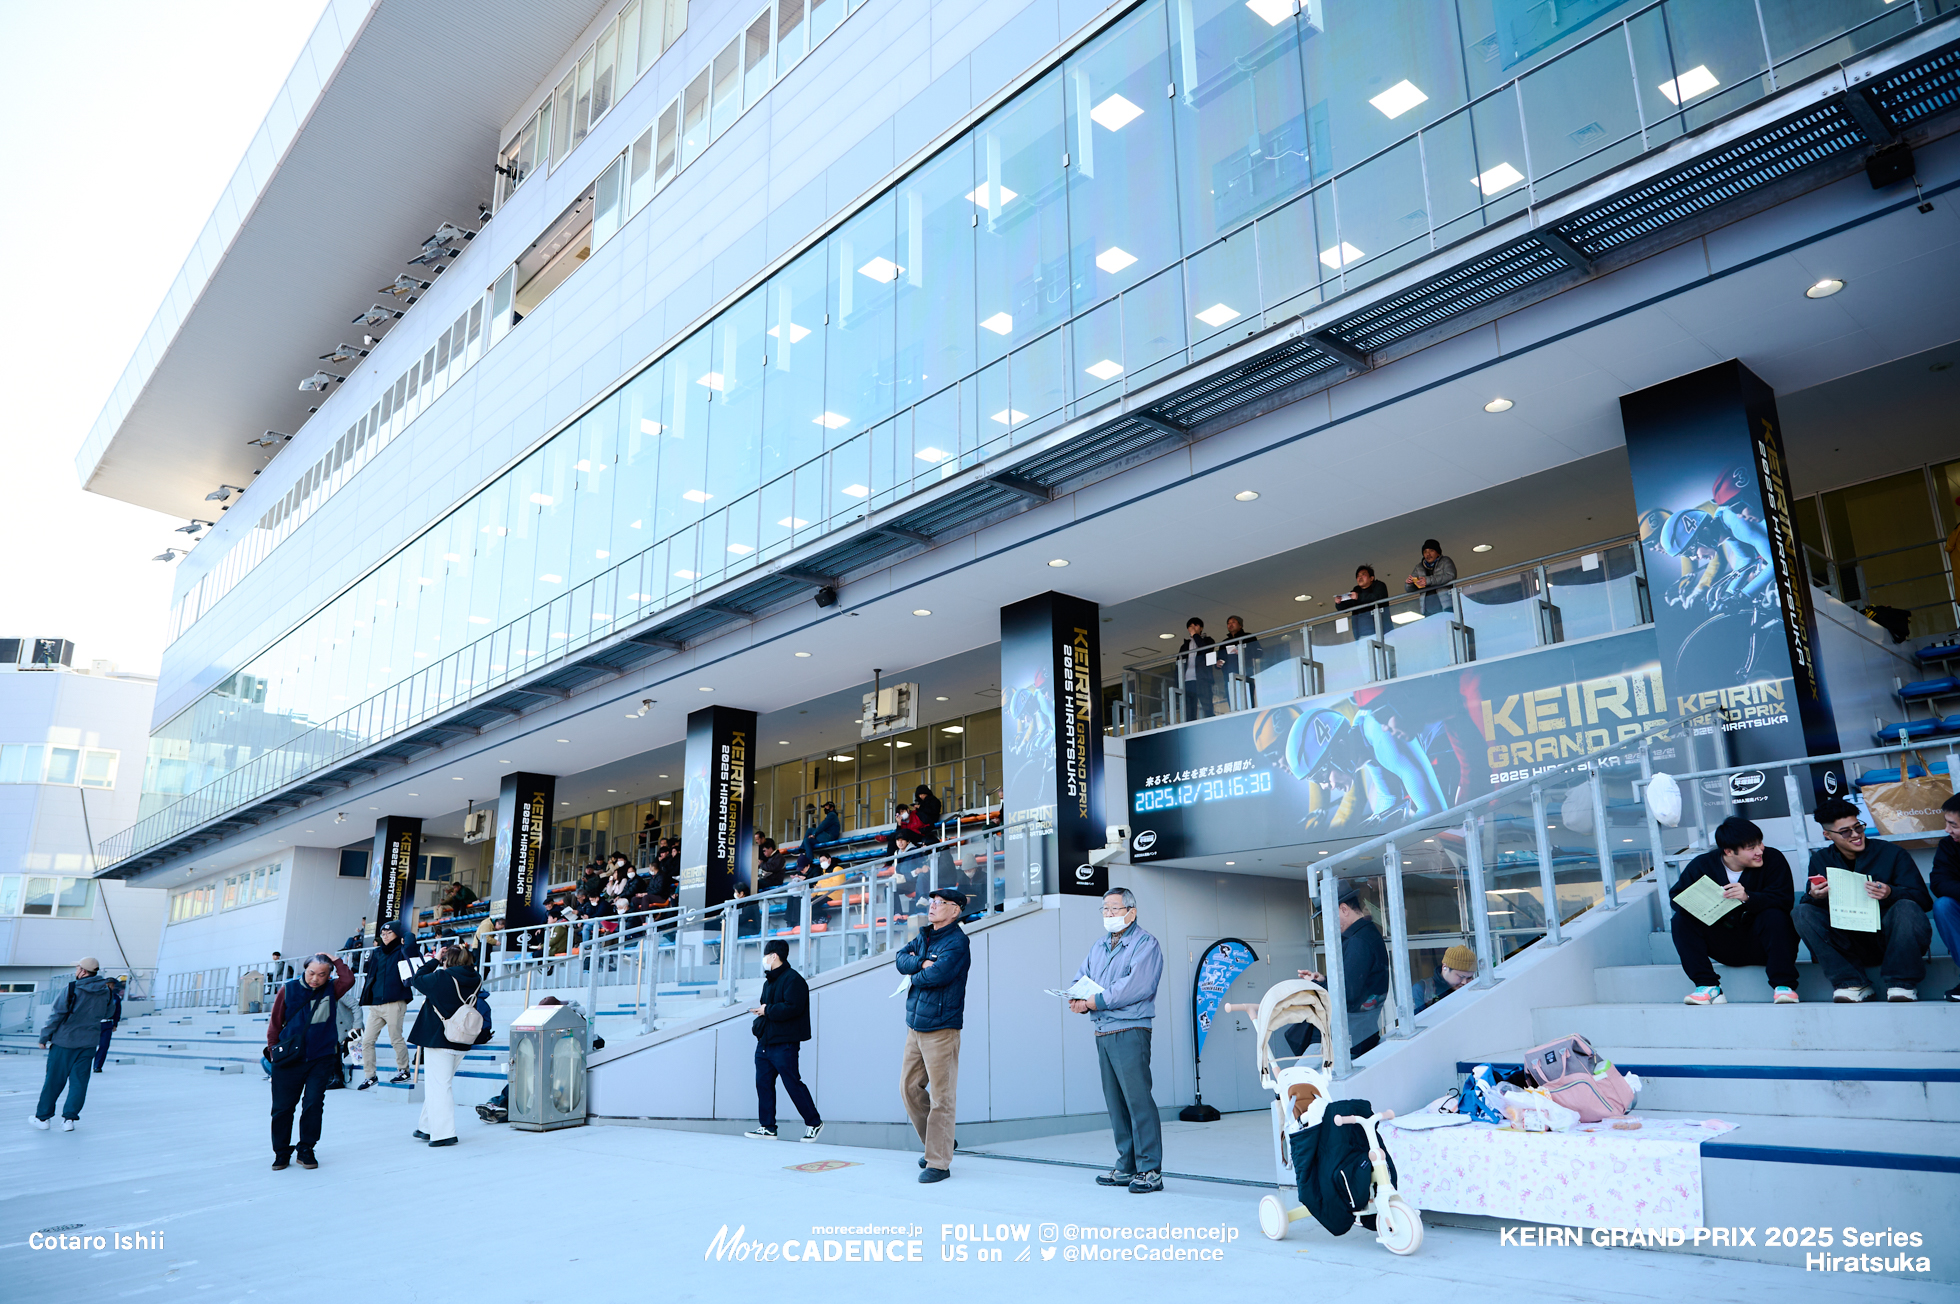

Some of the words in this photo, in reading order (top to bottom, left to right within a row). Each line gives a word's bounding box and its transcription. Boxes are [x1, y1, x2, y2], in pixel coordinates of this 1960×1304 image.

[1732, 466, 1750, 488] 3
[1647, 512, 1659, 530] 5
[1682, 515, 1697, 534] 4
[1758, 440, 1776, 510] 2025
[1772, 515, 1805, 667] HIRATSUKA
[1761, 417, 1796, 557] KEIRIN
[1787, 557, 1808, 642] GRAND
[1803, 645, 1819, 702] PRIX
[1063, 644, 1074, 692] 2025
[1073, 627, 1091, 722] KEIRIN
[1677, 680, 1784, 716] KEIRIN
[1744, 701, 1787, 720] PRIX
[1065, 695, 1077, 797] HIRATSUKA
[1313, 717, 1331, 746] 4
[1487, 728, 1611, 769] GRAND
[721, 744, 731, 781] 2025
[730, 731, 746, 803] KEIRIN
[1076, 723, 1087, 779] GRAND
[1145, 758, 1256, 787] 来るぞ、人生を変える瞬間が。
[1489, 769, 1529, 785] 2025
[1078, 782, 1089, 819] PRIX
[1135, 771, 1272, 812] 2025.12/30.16:30
[521, 802, 531, 832] 2025
[529, 791, 545, 849] KEIRIN
[717, 783, 729, 859] HIRATSUKA
[728, 803, 737, 846] GRAND
[1009, 805, 1053, 825] KEIRIN
[1035, 820, 1053, 830] PRIX
[391, 841, 400, 866] 2025
[397, 831, 412, 880] KEIRIN
[516, 833, 528, 895] HIRATSUKA
[526, 849, 535, 884] GRAND
[726, 847, 735, 876] PRIX
[385, 867, 397, 918] HIRATSUKA
[394, 880, 403, 908] GRAND
[524, 885, 533, 907] PRIX
